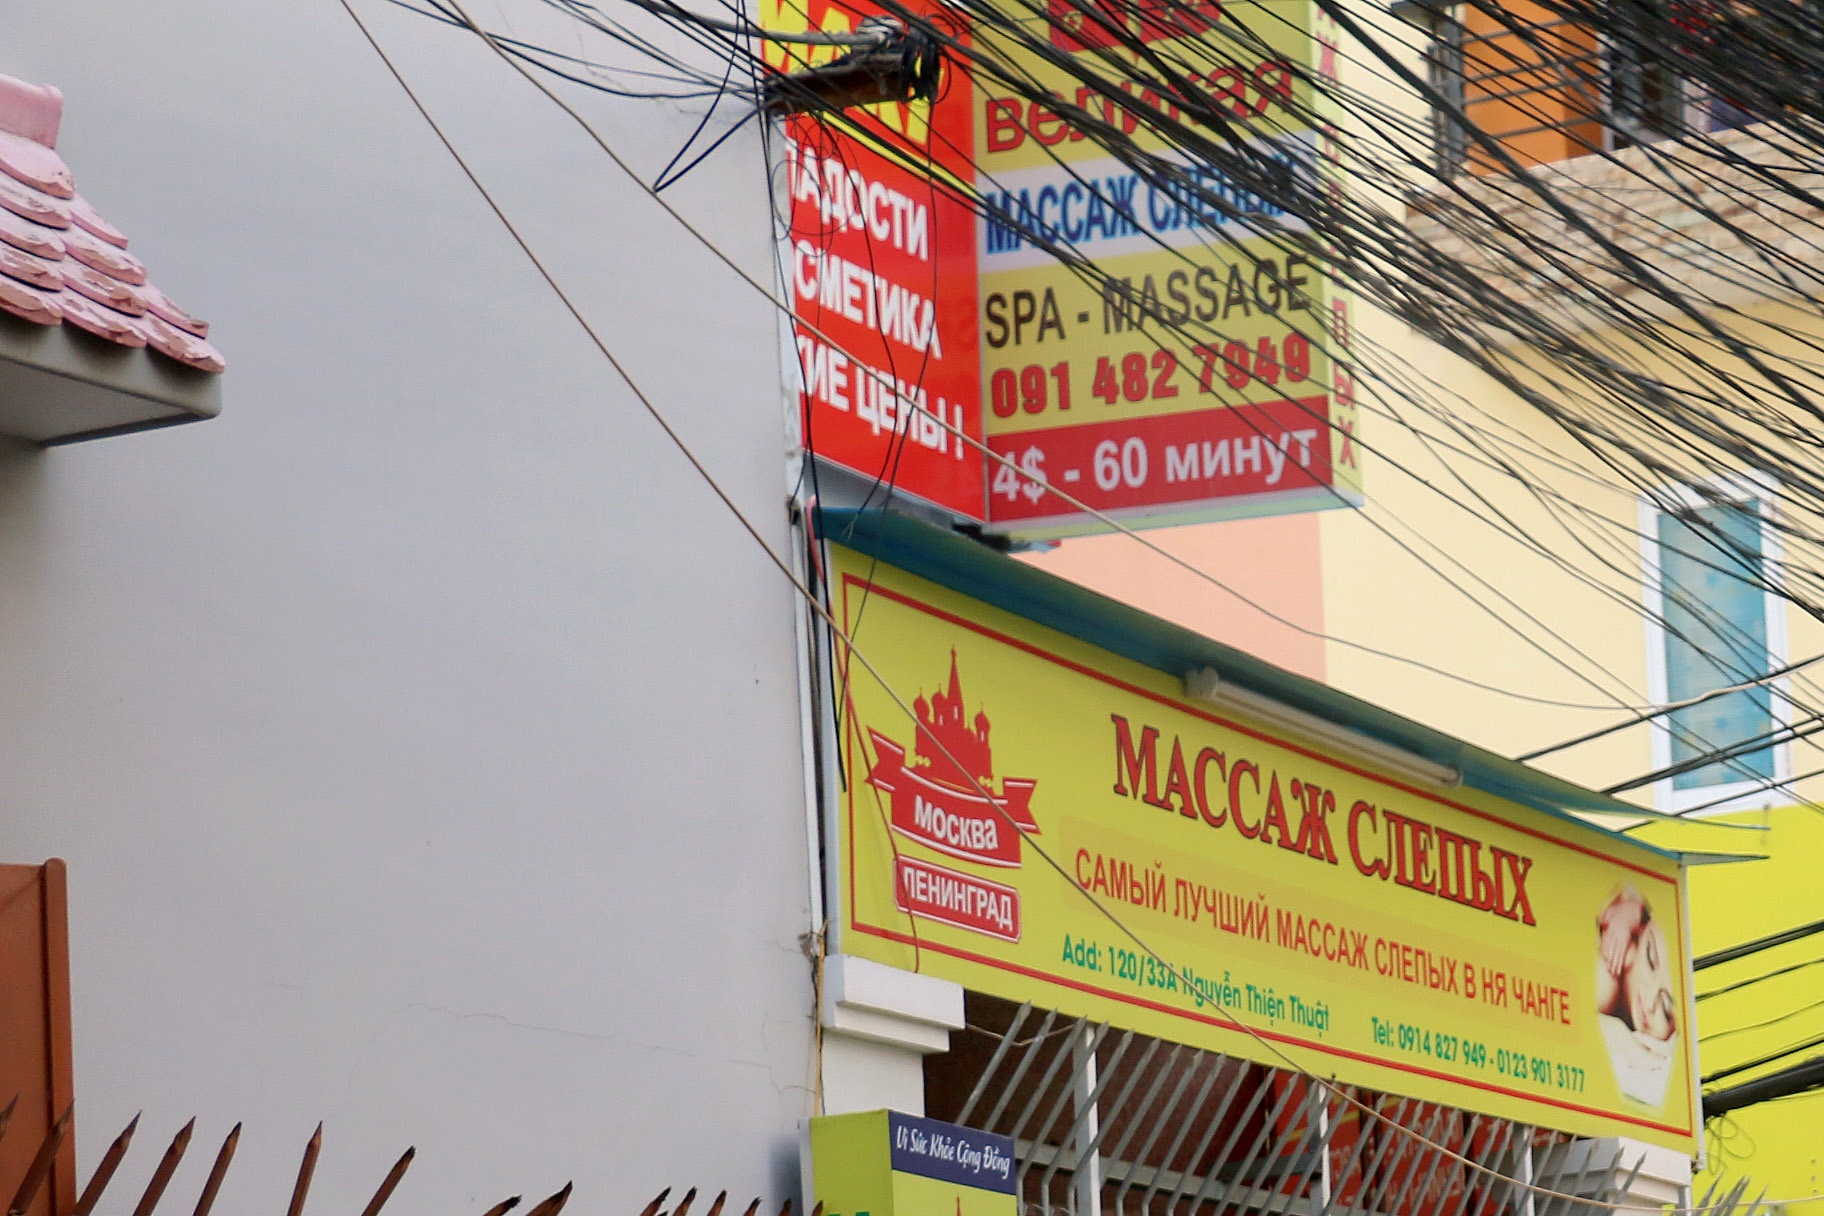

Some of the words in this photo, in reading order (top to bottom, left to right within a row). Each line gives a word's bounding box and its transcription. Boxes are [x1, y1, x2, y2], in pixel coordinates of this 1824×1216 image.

[985, 173, 1141, 256] МАССАЖ
[985, 288, 1066, 349] SPA
[1104, 254, 1312, 336] MASSAGE
[992, 360, 1070, 419] 091
[1093, 348, 1180, 406] 482
[1200, 332, 1312, 391] 7949
[994, 445, 1046, 504] 4$
[1101, 440, 1148, 491] 60
[1165, 428, 1319, 486] минут
[1110, 712, 1338, 866] МАССАЖ
[1347, 800, 1538, 927] СЛЕПЫХ
[903, 866, 1014, 932] ЛЕНИНГРАД
[1075, 847, 1167, 914] САМЫЙ
[1173, 874, 1271, 945] ЛУЧШИЙ
[1276, 907, 1370, 971] МАССАЖ
[1375, 937, 1460, 998] СЛЕПЫХ
[1464, 962, 1477, 999] В
[1482, 967, 1508, 1009] НЯ
[1512, 976, 1572, 1026] ЧАНГЕ
[1062, 933, 1103, 973] Add:
[1245, 983, 1286, 1026] Thiện
[1289, 995, 1330, 1038] Thuật
[1371, 1016, 1395, 1048] Tel:
[1398, 1023, 1431, 1056] 0914
[1435, 1033, 1458, 1062] 827
[1463, 1041, 1486, 1069] 949
[1497, 1048, 1529, 1080] 0123
[1531, 1058, 1553, 1086] 901
[1557, 1063, 1586, 1093] 3177
